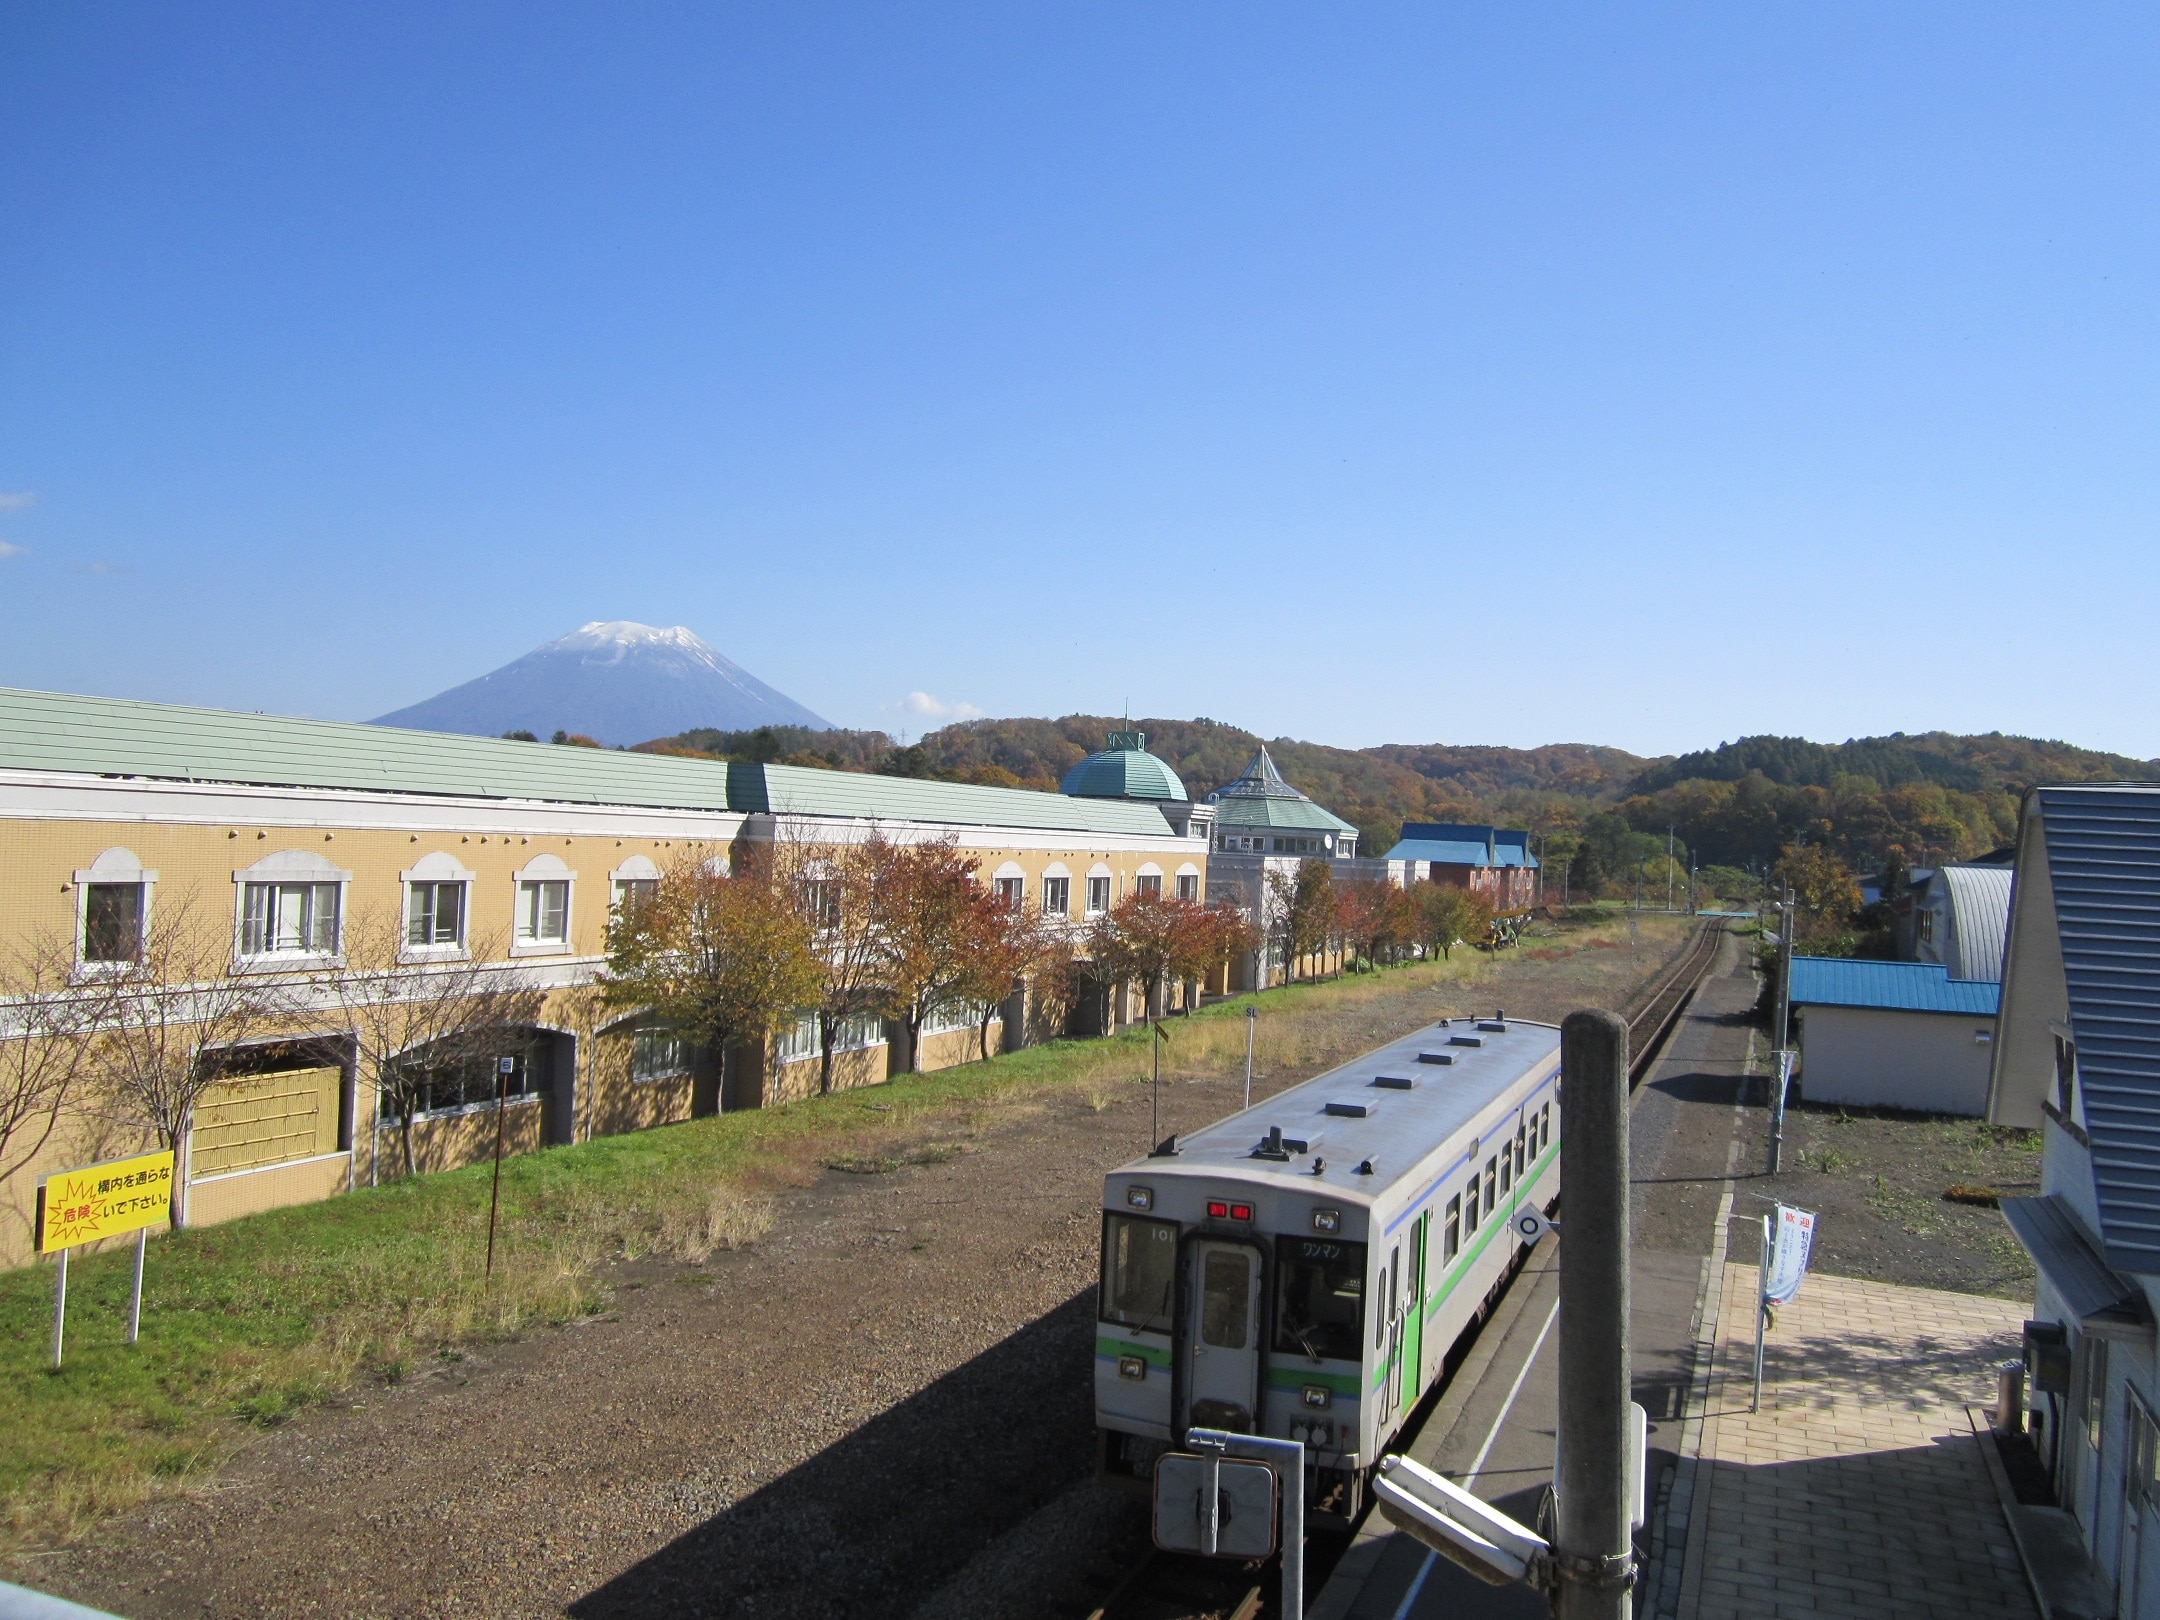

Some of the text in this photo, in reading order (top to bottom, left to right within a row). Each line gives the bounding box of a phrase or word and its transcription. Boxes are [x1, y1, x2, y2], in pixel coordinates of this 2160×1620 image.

[1246, 1007, 1256, 1018] SL
[97, 1166, 170, 1195] 構内を通らな
[63, 1204, 91, 1224] 危険
[103, 1193, 168, 1218] いで下さい。
[1152, 1227, 1174, 1243] 101
[1303, 1242, 1340, 1259] ワンマン
